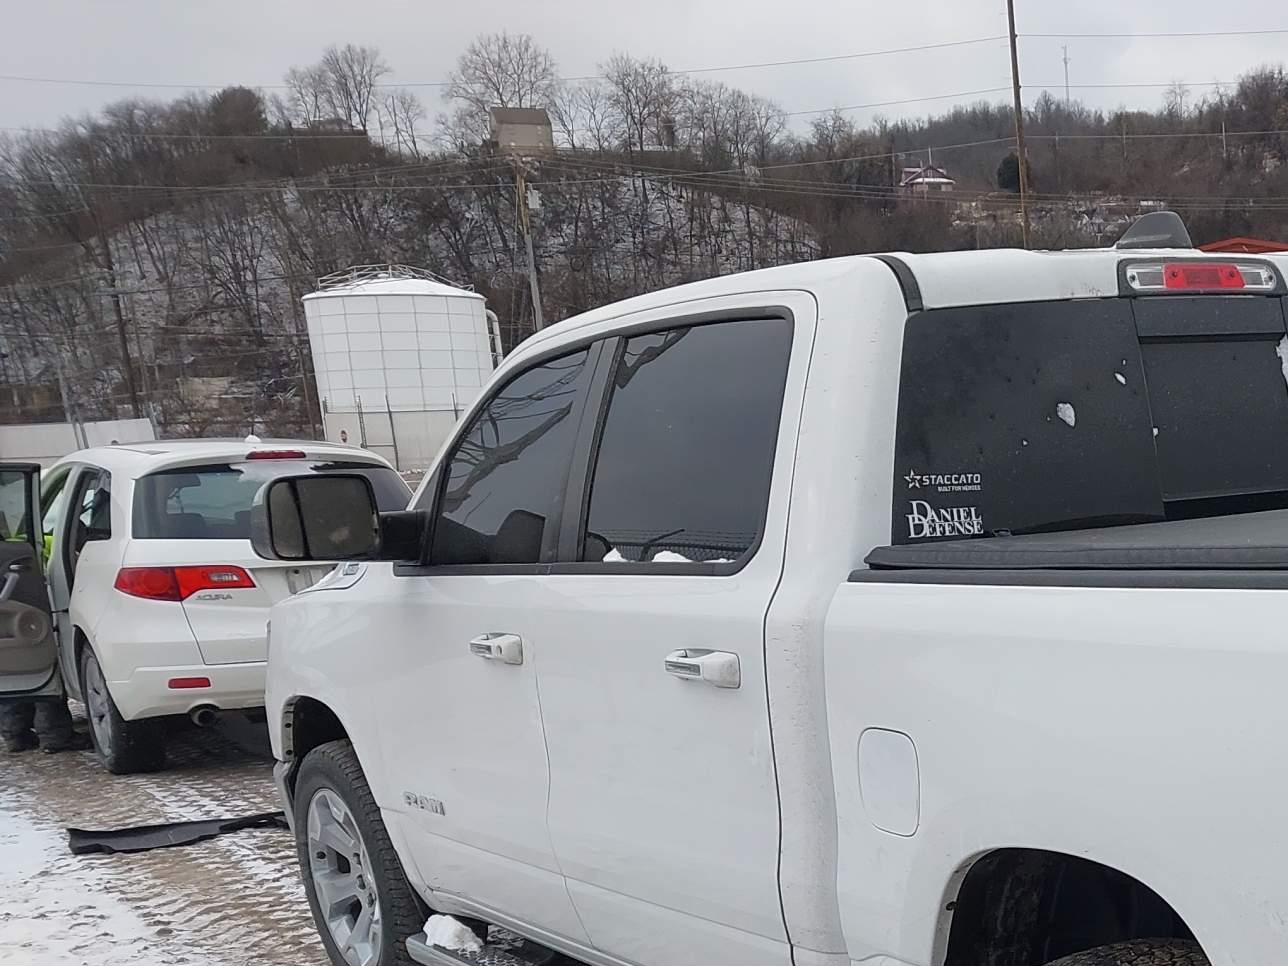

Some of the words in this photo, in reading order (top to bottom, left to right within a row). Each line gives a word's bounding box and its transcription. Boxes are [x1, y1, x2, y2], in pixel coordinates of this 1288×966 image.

[922, 473, 981, 485] STACCATO
[908, 500, 982, 523] DANIEL
[905, 514, 984, 539] DEFENSE
[195, 593, 233, 601] ACURA
